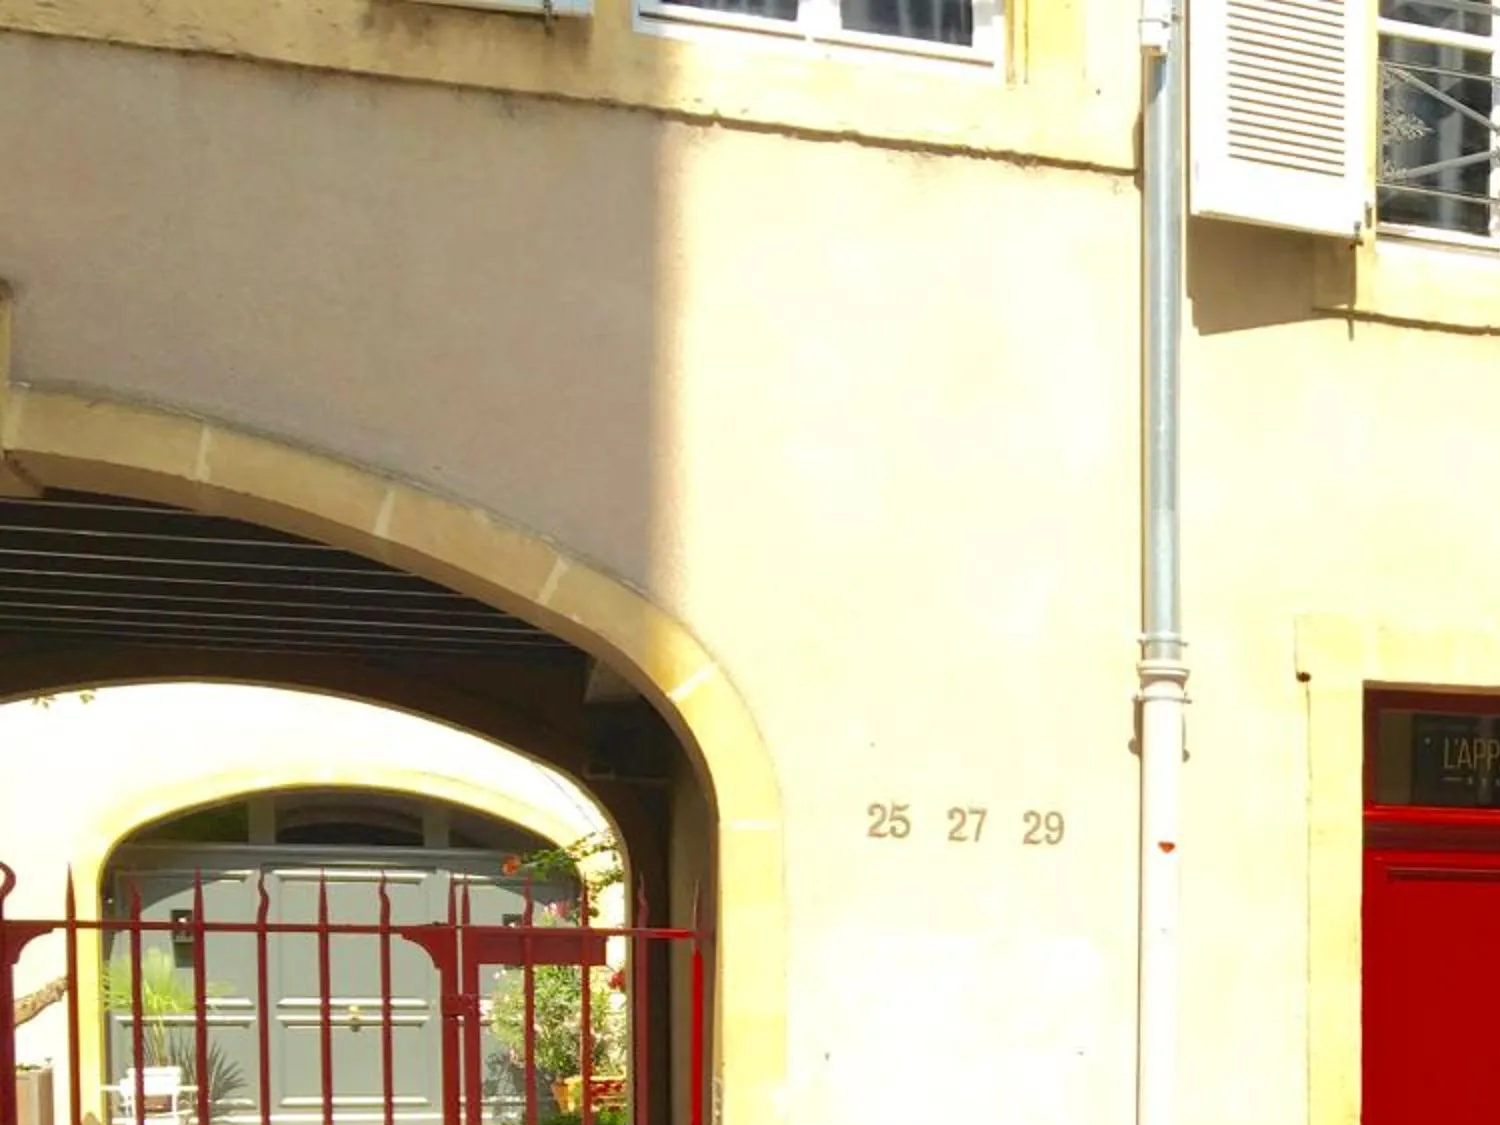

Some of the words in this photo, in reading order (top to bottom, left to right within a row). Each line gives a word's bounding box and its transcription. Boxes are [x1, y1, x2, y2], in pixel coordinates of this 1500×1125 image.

[867, 802, 911, 839] 25
[947, 806, 988, 843] 27
[1023, 809, 1065, 846] 29
